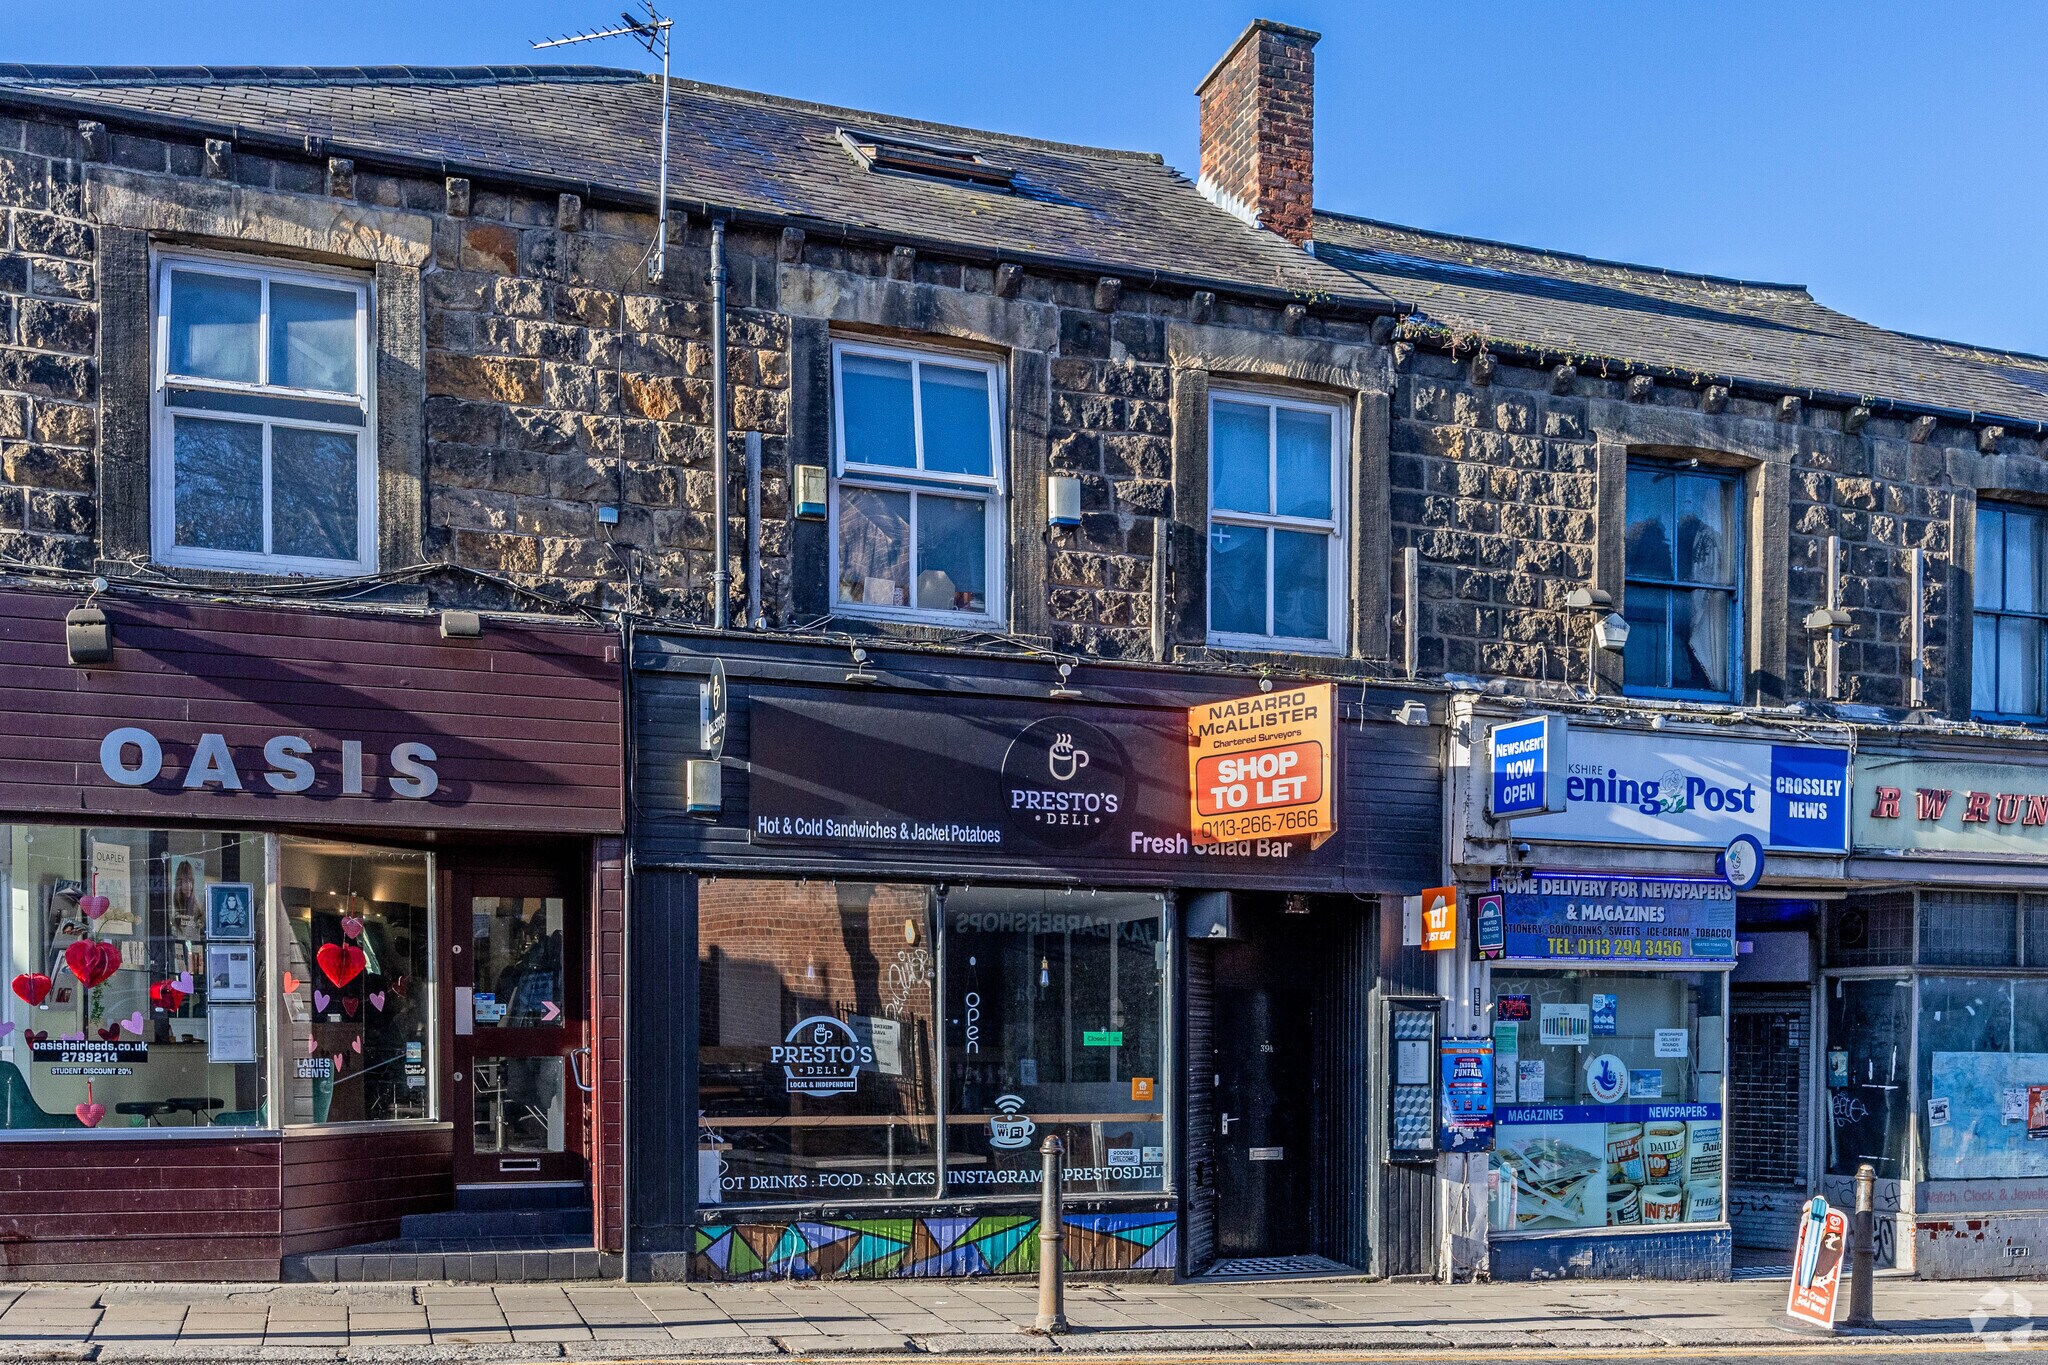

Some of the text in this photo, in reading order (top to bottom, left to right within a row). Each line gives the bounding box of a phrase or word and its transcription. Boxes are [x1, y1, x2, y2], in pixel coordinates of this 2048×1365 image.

[1209, 692, 1306, 720] NABARRO
[1199, 706, 1318, 737] McALLISTER
[1213, 729, 1302, 749] Chartered Surveyors
[1496, 736, 1545, 758] NEWSAGENT
[100, 727, 439, 798] OASIS
[1218, 751, 1298, 784] SHOP
[1506, 758, 1535, 781] NOW
[1211, 776, 1308, 810] TO LET
[1503, 782, 1535, 805] OPEN
[1686, 776, 1756, 814] Post
[1775, 776, 1842, 797] CROSSLEY
[1011, 790, 1118, 813] PRESTO'S
[1789, 801, 1828, 820] NEWS
[1871, 785, 1901, 818] R
[1916, 788, 1952, 820] W
[1047, 813, 1089, 826] DELI
[1201, 810, 1318, 839] 0113-266-7666
[758, 816, 1001, 843] Hot & Cold Sandwiches & Jacket Potatoes
[1131, 832, 1188, 855] Fresh
[1257, 838, 1293, 858] Bar
[96, 852, 125, 864] OLAPLEX
[1496, 879, 1732, 901] HOME DELIVERY FOR NEWSPAPERS
[1567, 904, 1665, 923] & MAGAZINES
[1425, 930, 1451, 943] JUST EAT
[1549, 925, 1569, 935] COLD
[1571, 926, 1602, 936] DRINKS
[1609, 927, 1640, 937] SWEETS
[1647, 928, 1689, 938] ICE-CREAM
[1696, 928, 1732, 938] TOBACCO
[1548, 938, 1682, 957] TEL: 0113 294 3456
[33, 1040, 148, 1052] oasishairleeds.co.uk
[771, 1045, 873, 1063] PRESTO'S
[62, 1052, 118, 1062] 2789214
[297, 1058, 331, 1068] LADIES
[51, 1067, 132, 1075] STUDENT DISCOUNT 20%
[298, 1068, 331, 1078] GENTS
[807, 1066, 837, 1075] DELI
[1453, 1069, 1483, 1078] FUNFAIR
[1597, 1090, 1616, 1100] National
[1508, 1106, 1708, 1122] MAGAZINES NEWSPAPERS
[1650, 1140, 1678, 1152] DAILY
[750, 1175, 807, 1189] DRINKS
[819, 1174, 863, 1187] FOOD
[874, 1172, 936, 1186] SNACKS
[947, 1166, 1165, 1184] INSTAGRAM PRESTOSDEL
[1963, 1189, 1994, 1202] Clock
[2000, 1188, 2008, 1201] &
[1797, 1296, 1810, 1308] Sold
